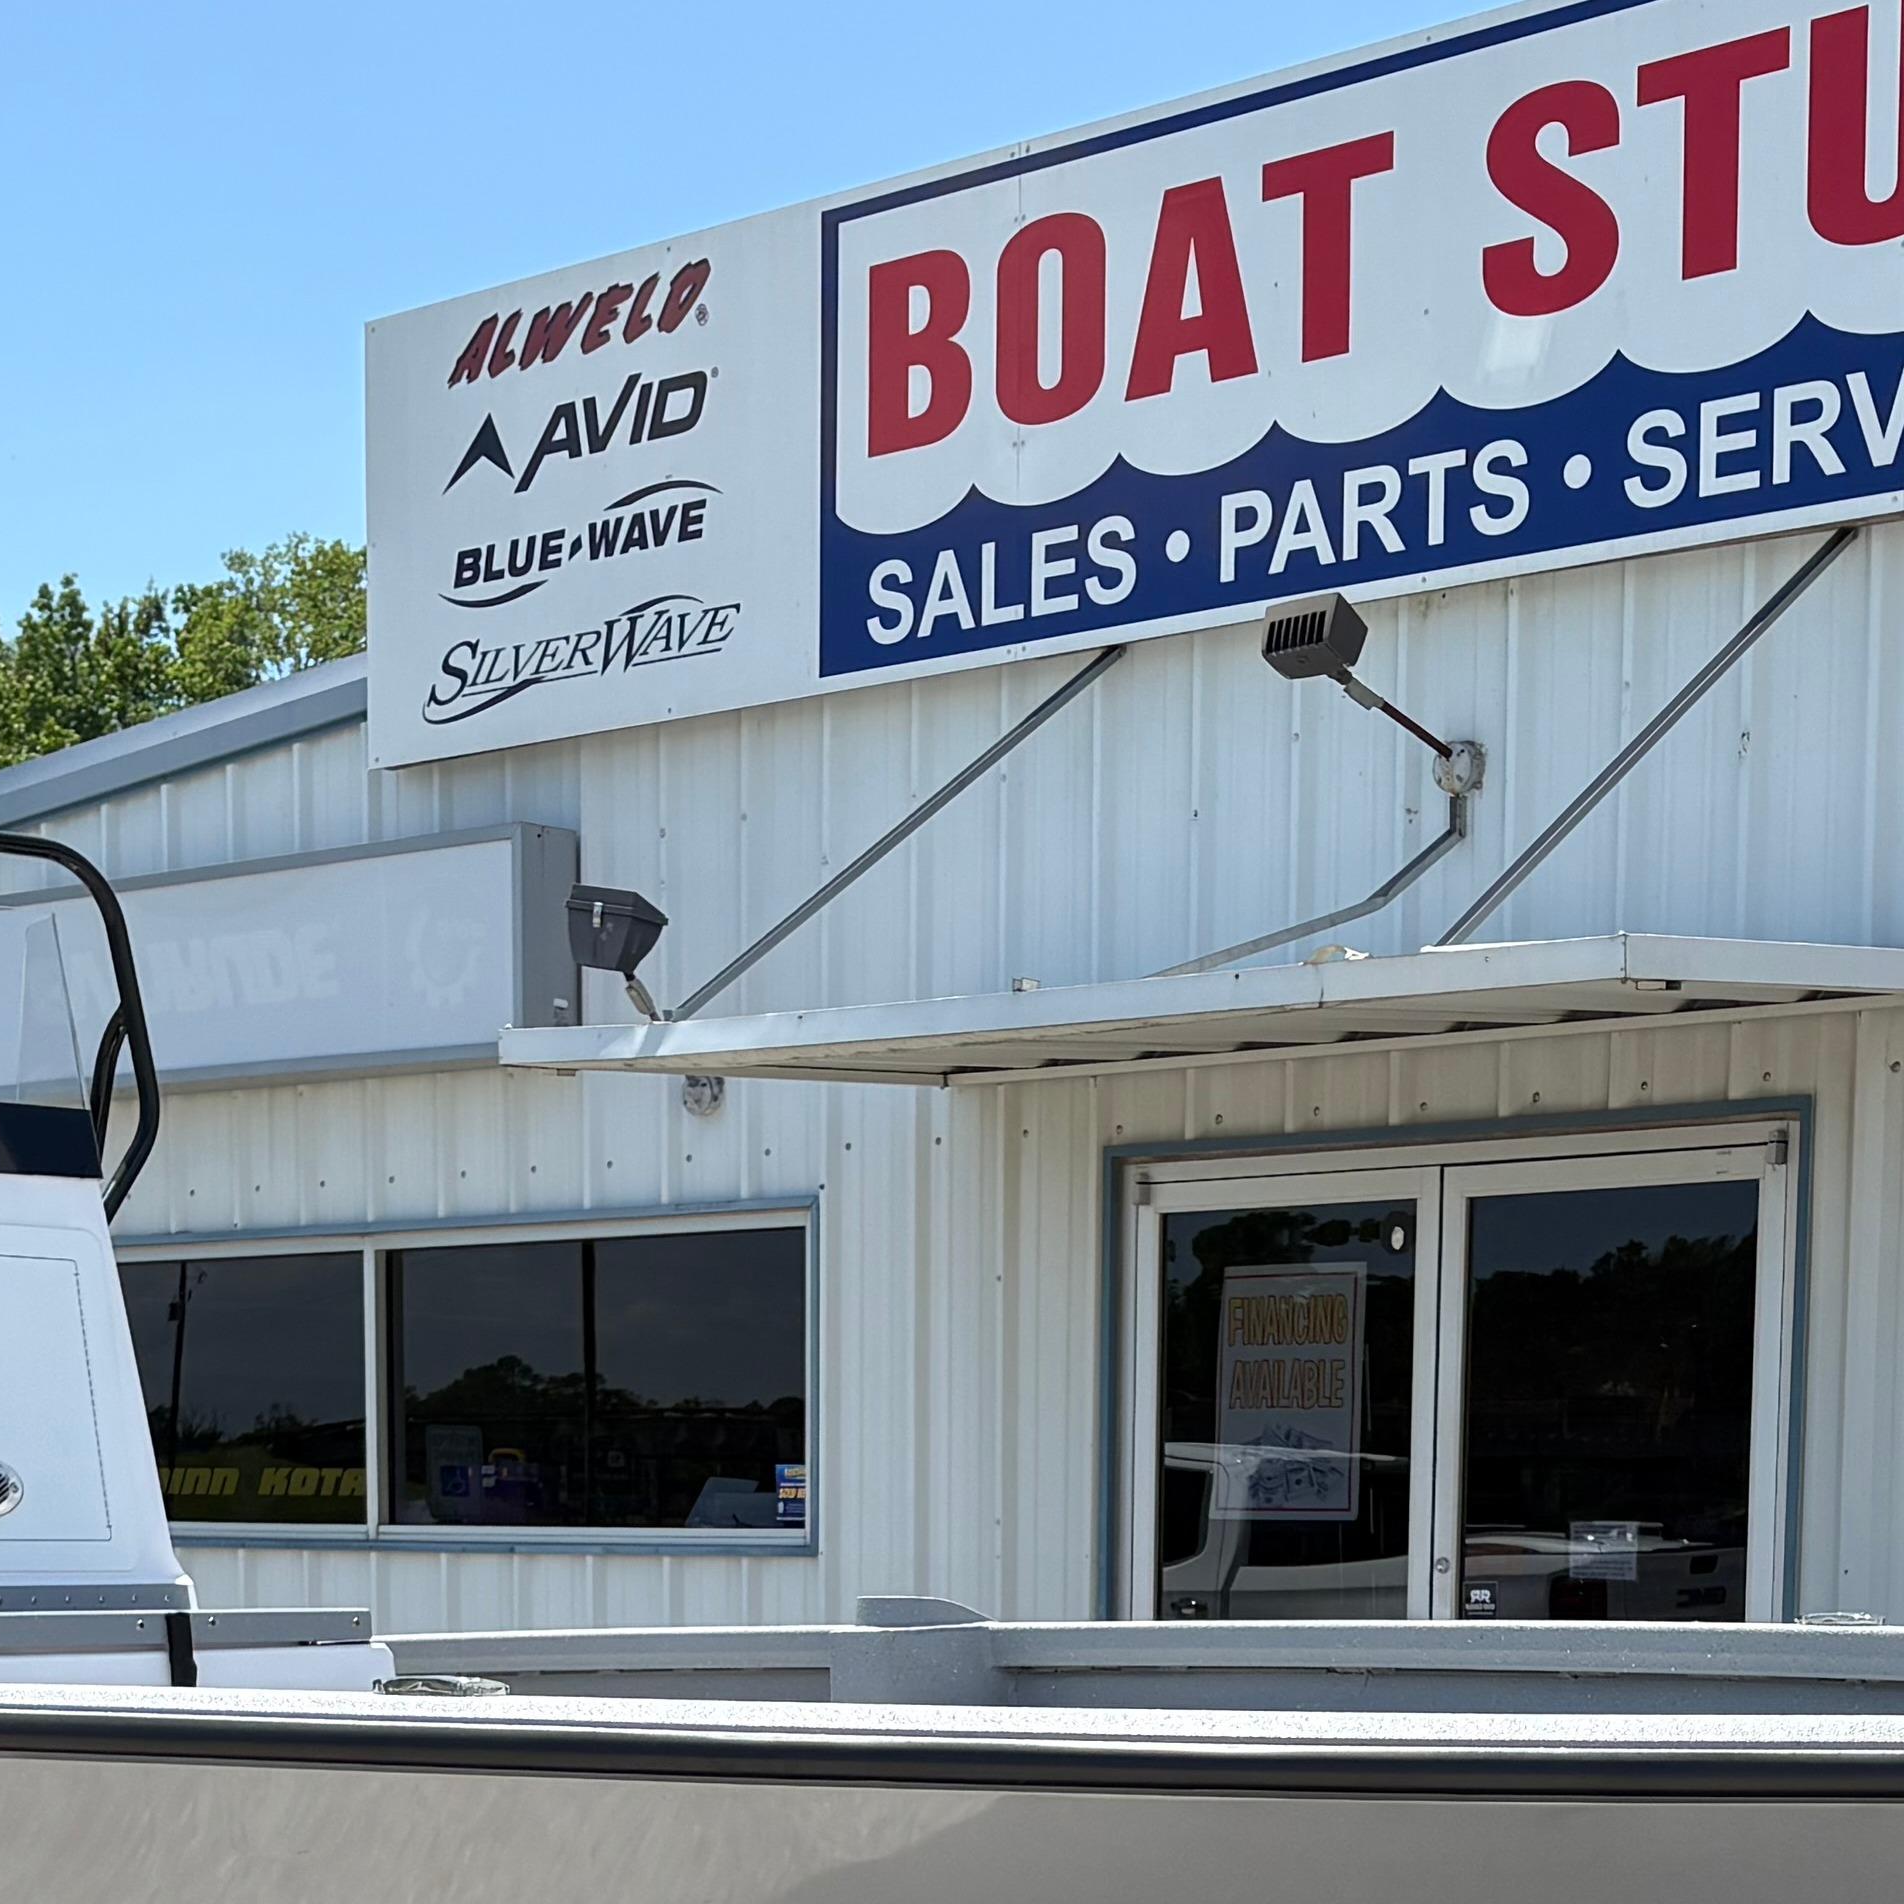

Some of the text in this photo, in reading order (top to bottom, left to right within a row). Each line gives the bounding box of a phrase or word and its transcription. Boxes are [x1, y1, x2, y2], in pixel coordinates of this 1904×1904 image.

[448, 258, 712, 388] ALWELD
[868, 131, 1395, 458] BOAT
[514, 370, 709, 493] AVID
[865, 515, 1137, 645] SALES
[1219, 438, 1529, 584] PARTS
[1228, 1294, 1349, 1347] FINANCING
[1229, 1359, 1346, 1410] AVAILABLE
[257, 1467, 367, 1496] KOTA
